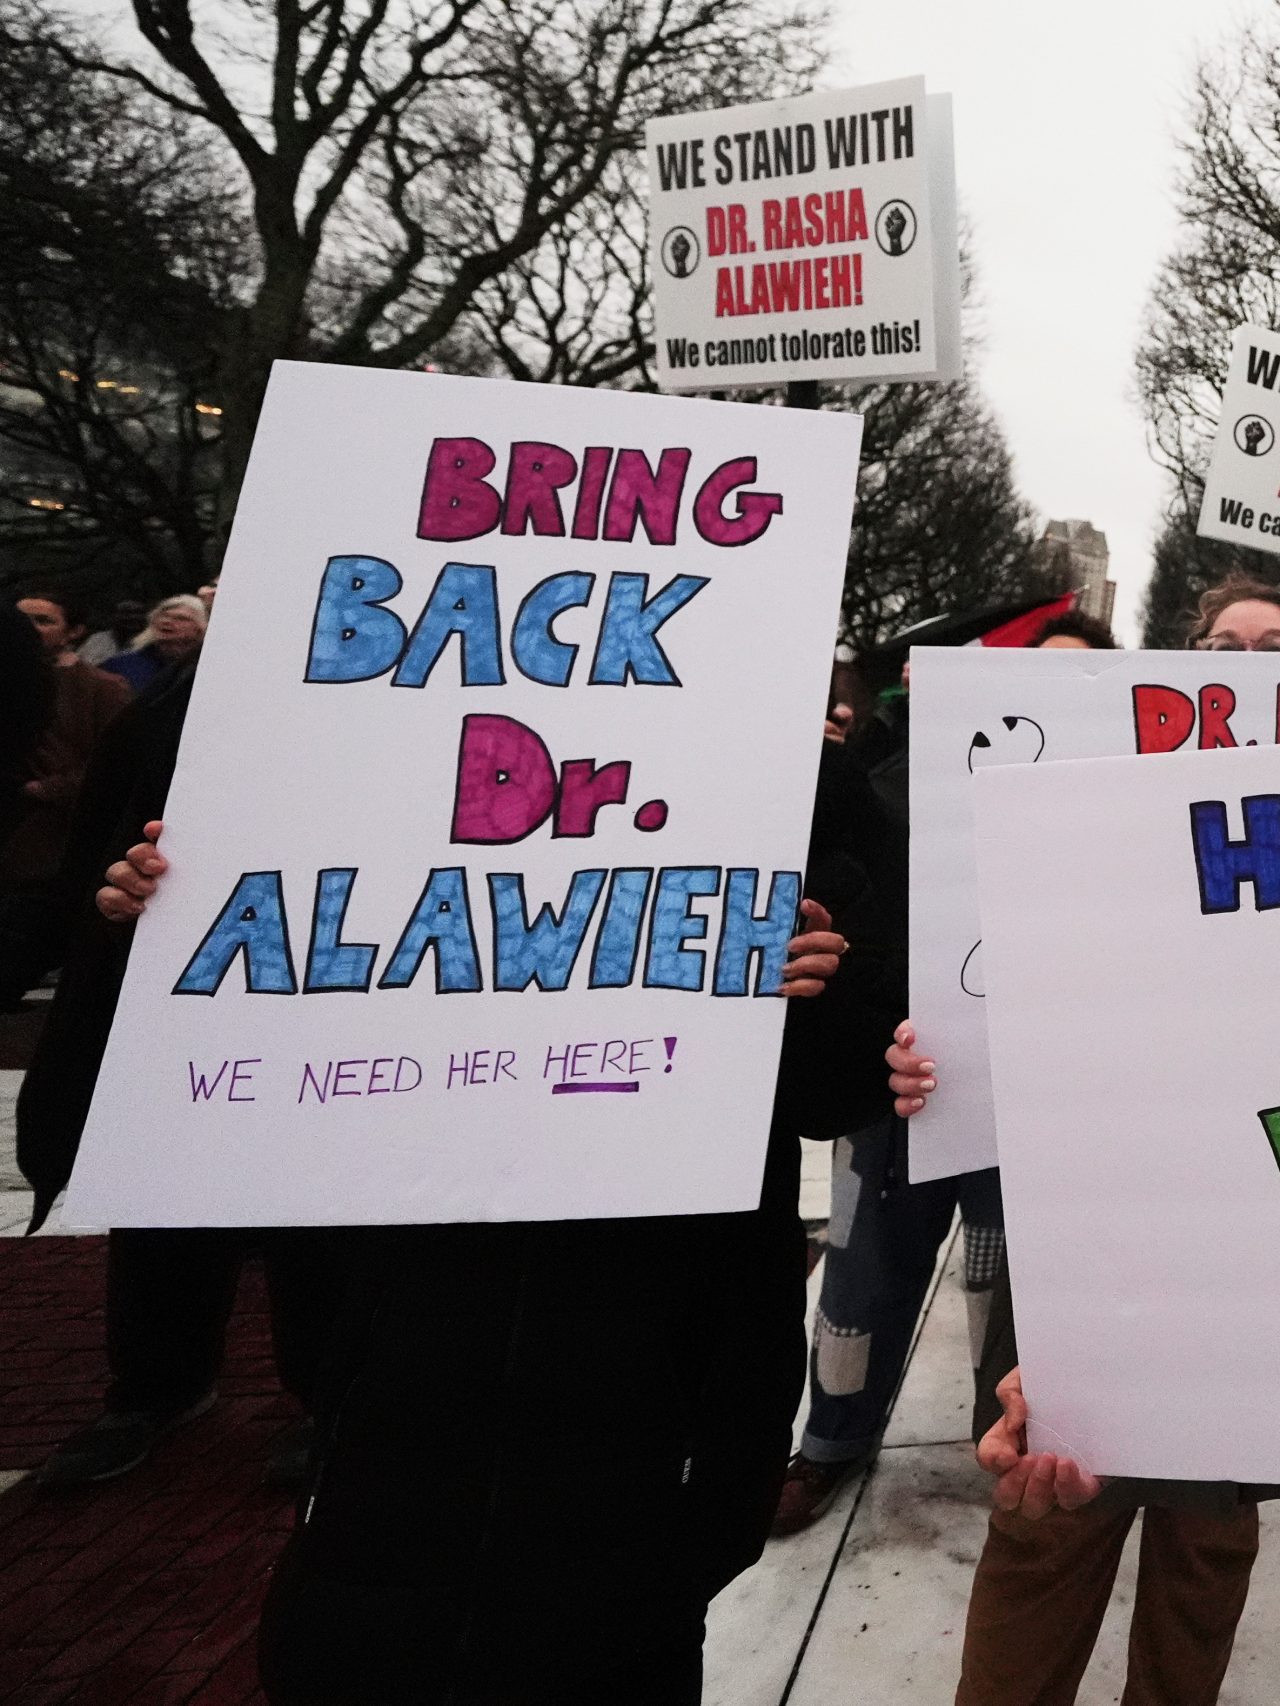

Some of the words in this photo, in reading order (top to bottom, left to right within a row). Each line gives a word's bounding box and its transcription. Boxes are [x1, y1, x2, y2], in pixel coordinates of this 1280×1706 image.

[657, 139, 706, 191] WE
[714, 123, 816, 185] STAND
[825, 105, 914, 170] WITH
[706, 204, 756, 257] DR.
[762, 187, 868, 251] RASHA
[715, 253, 863, 318] ALAWIEH!
[667, 338, 700, 368] We
[704, 333, 776, 366] cannot
[781, 327, 866, 362] tolorate
[870, 319, 921, 354] this!
[417, 437, 783, 547] BRING
[1219, 497, 1255, 529] We
[303, 555, 712, 688] BACK
[450, 713, 669, 845] Dr.
[171, 865, 802, 998] ALAWIEH
[188, 1058, 262, 1102] WE
[298, 1056, 422, 1104] NEED
[446, 1050, 517, 1090] HER
